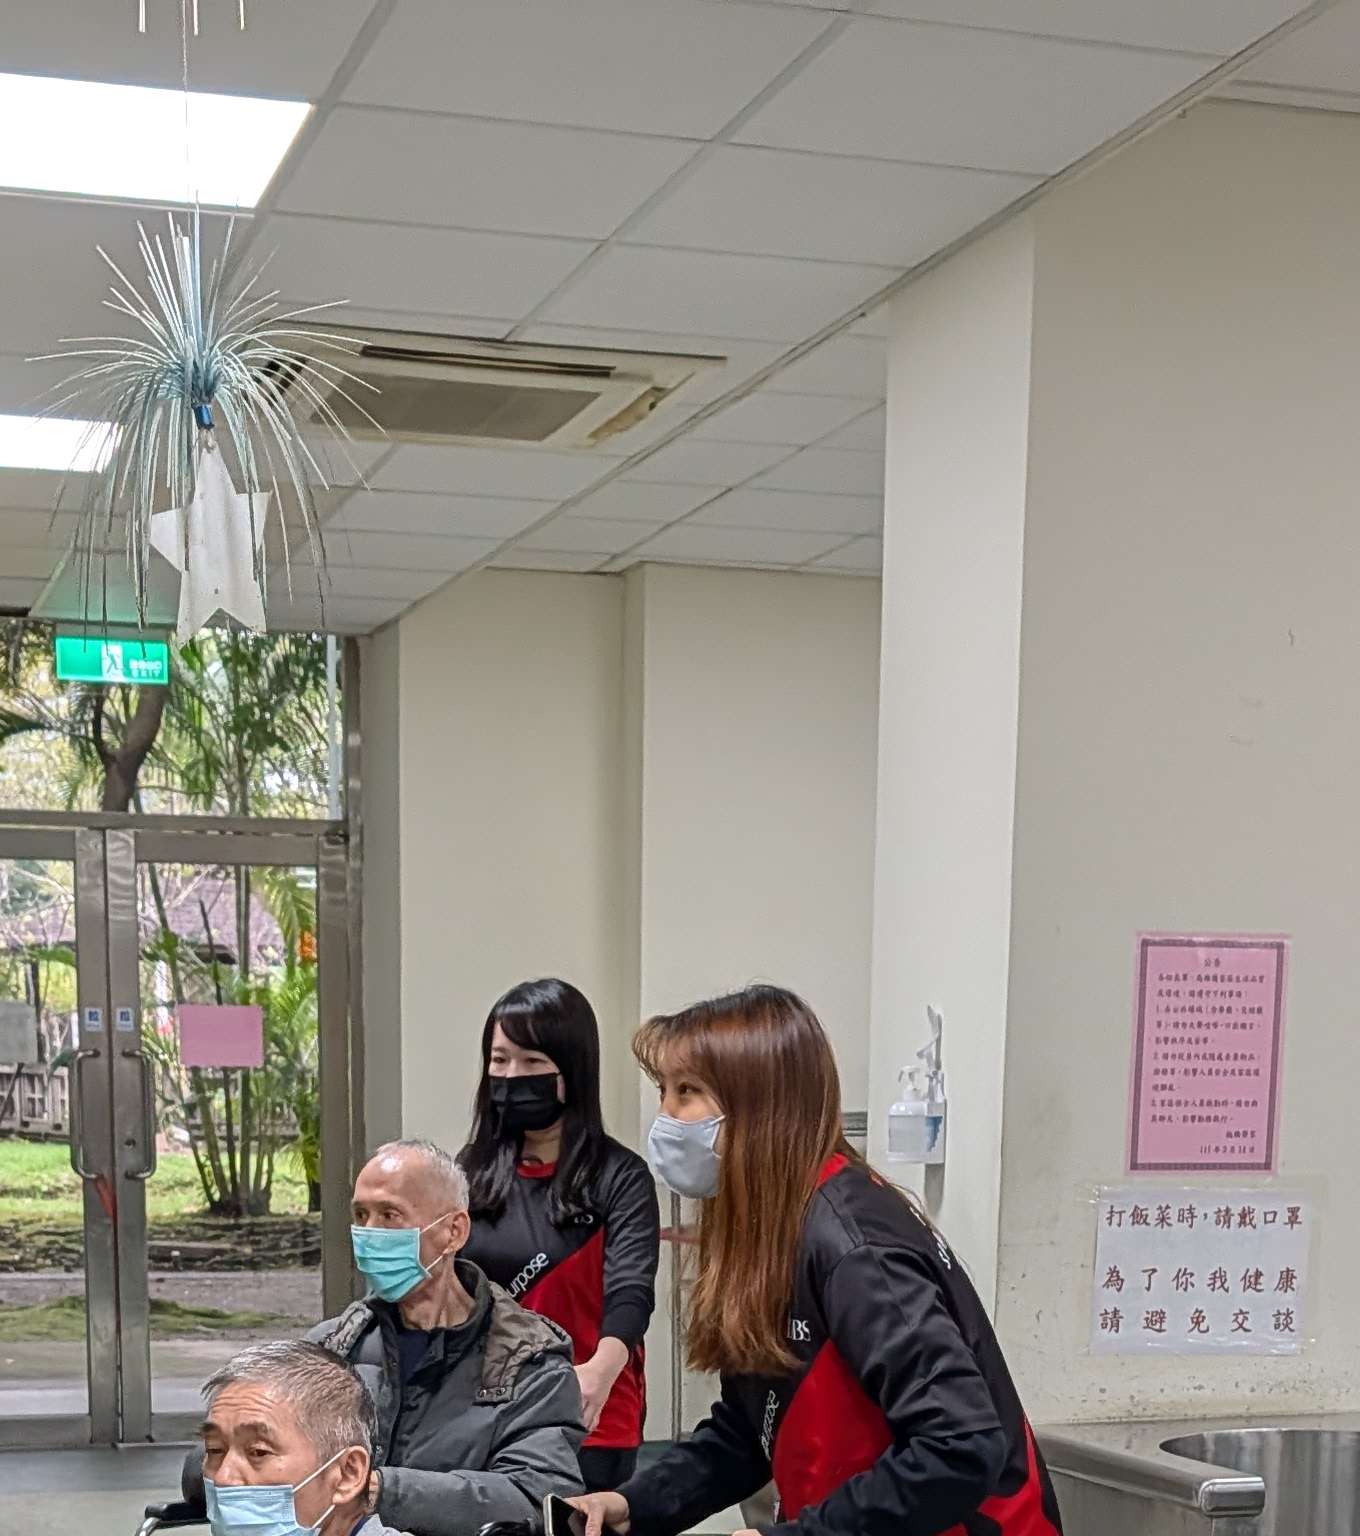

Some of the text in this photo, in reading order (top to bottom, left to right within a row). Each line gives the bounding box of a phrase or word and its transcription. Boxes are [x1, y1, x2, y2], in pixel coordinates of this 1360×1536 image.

[1106, 1204, 1303, 1229] 打飯菜時，請戴口罩
[506, 1252, 549, 1297] urpose
[1102, 1267, 1297, 1293] 為了你我健康
[786, 1319, 811, 1342] BS
[1100, 1308, 1296, 1334] 請避免交談
